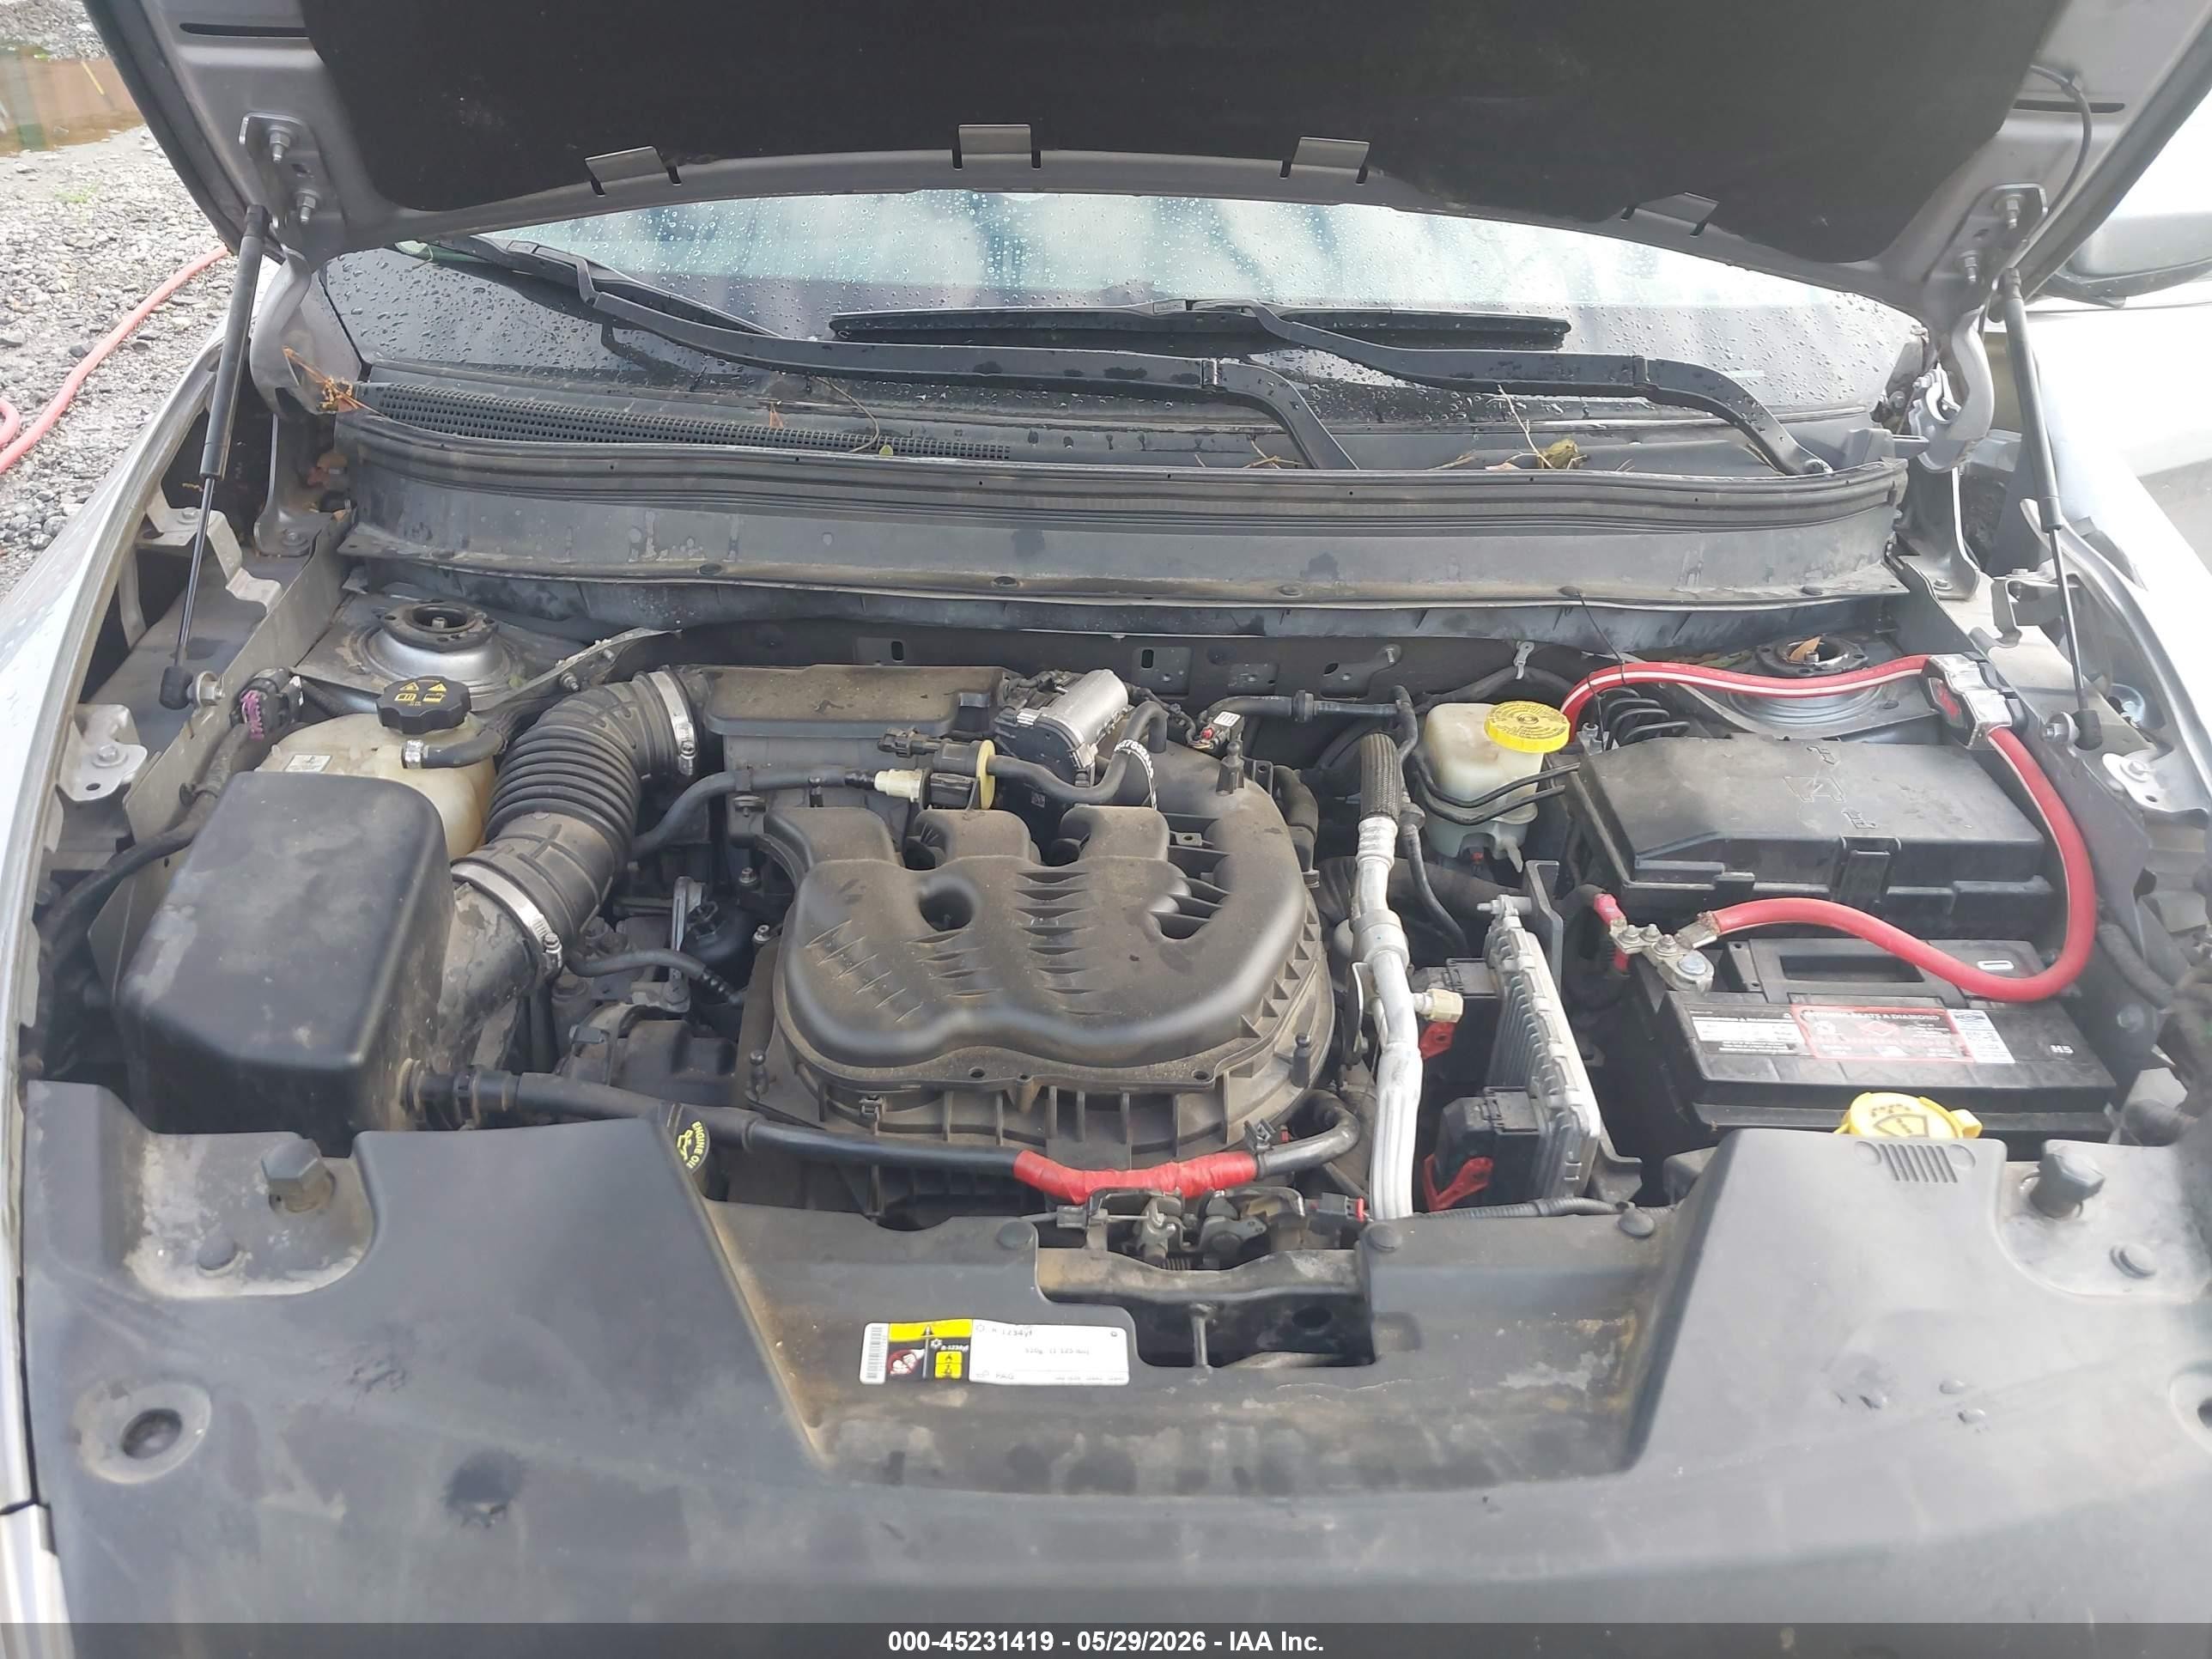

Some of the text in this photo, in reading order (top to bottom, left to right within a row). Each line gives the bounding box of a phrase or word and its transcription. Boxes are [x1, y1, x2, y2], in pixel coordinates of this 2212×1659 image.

[2050, 1044, 2075, 1054] H5
[686, 1121, 705, 1169] ENGINE OIL
